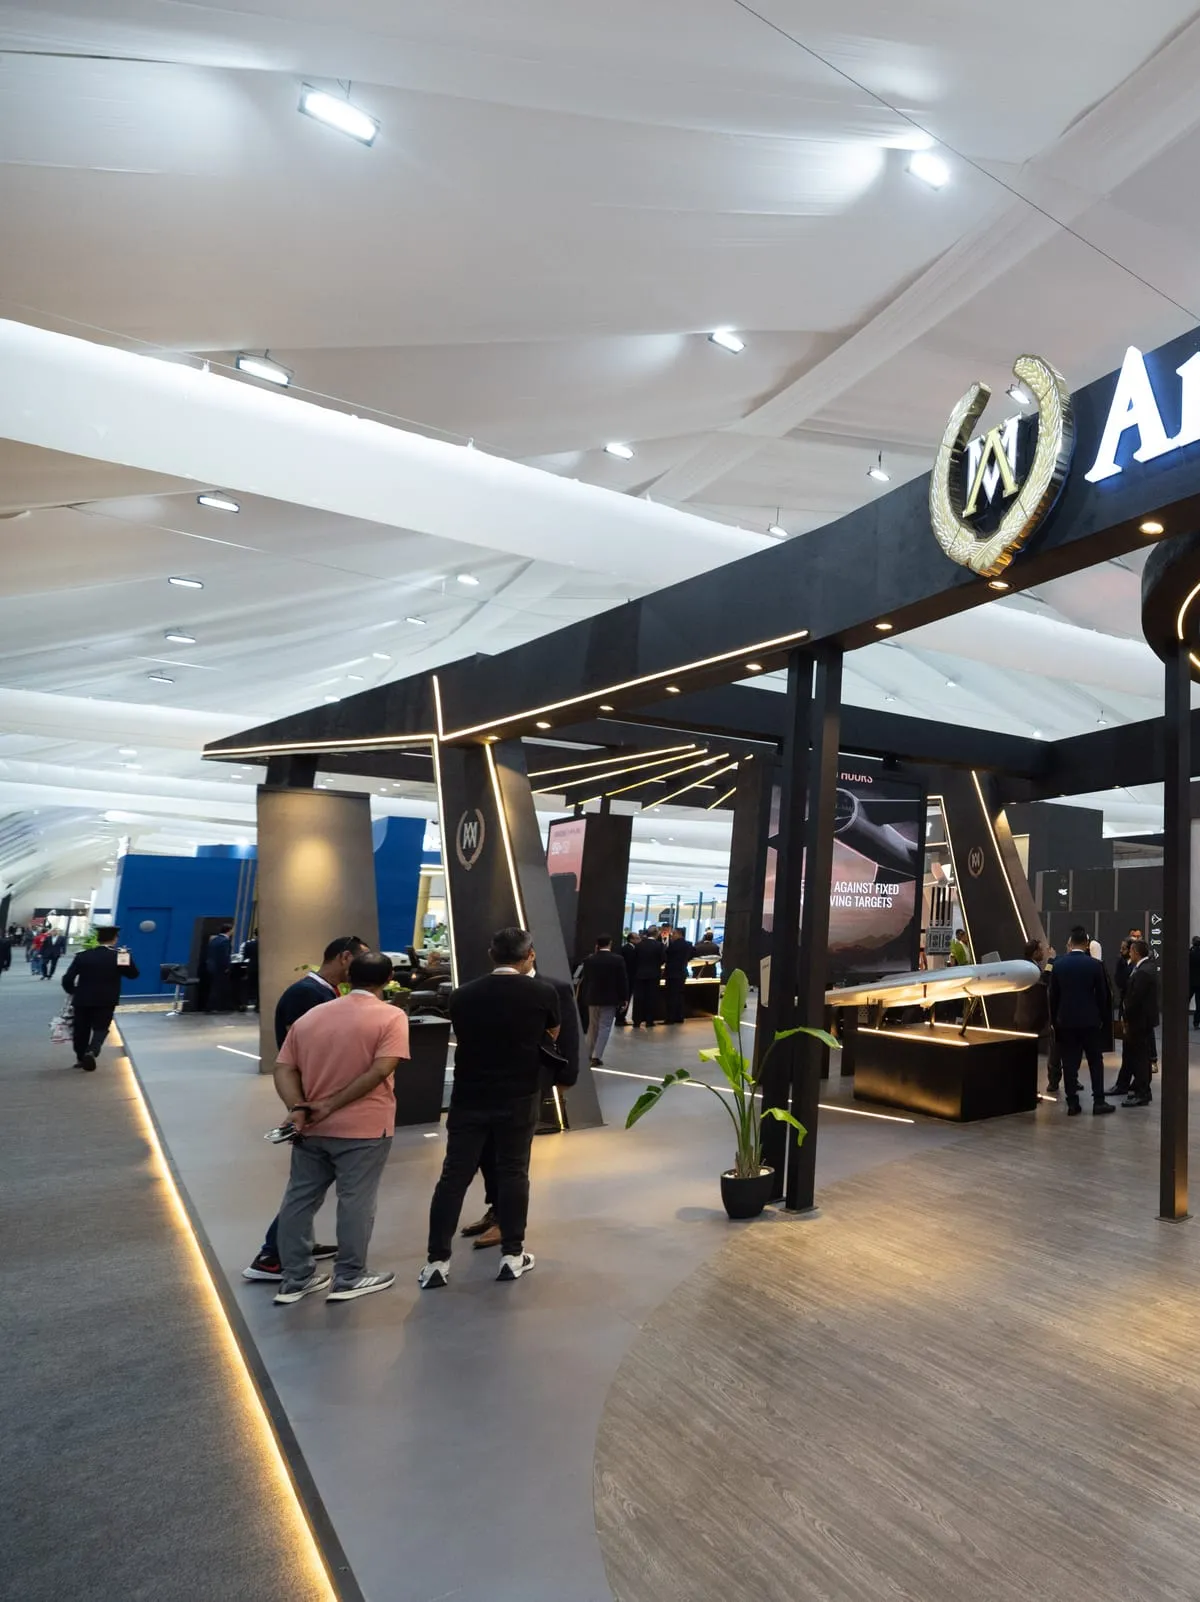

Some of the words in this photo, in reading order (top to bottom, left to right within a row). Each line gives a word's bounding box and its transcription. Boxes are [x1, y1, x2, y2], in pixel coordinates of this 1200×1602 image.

[834, 881, 873, 894] AGAINST
[875, 883, 900, 895] FIXED
[830, 896, 852, 907] VING
[854, 896, 893, 908] TARGETS
